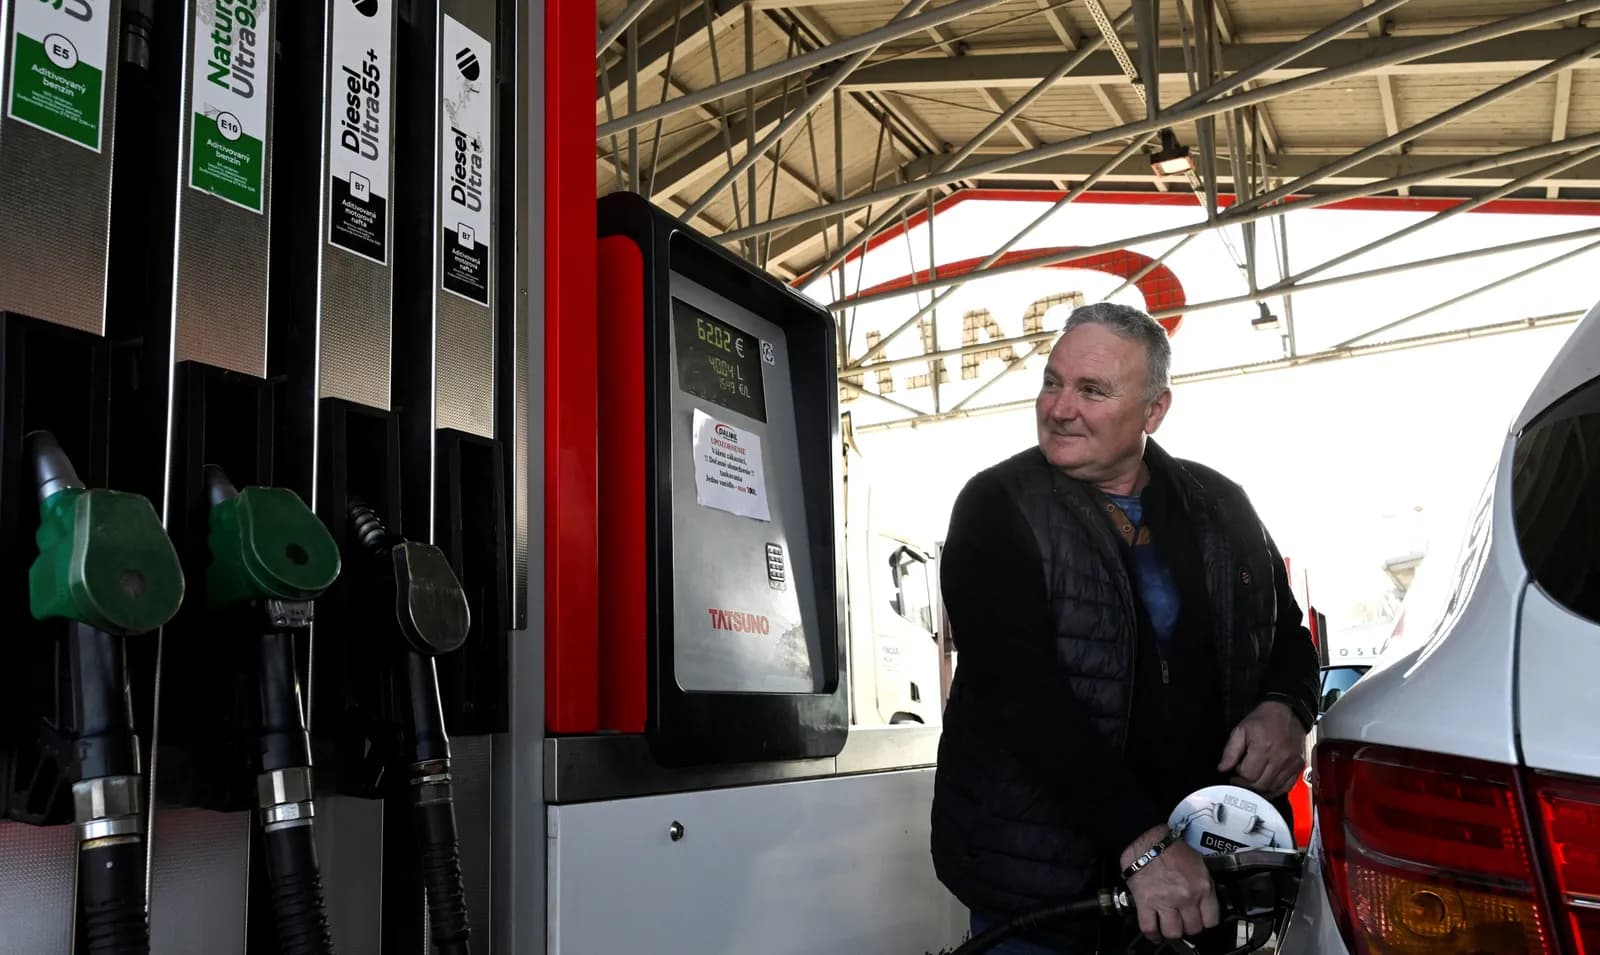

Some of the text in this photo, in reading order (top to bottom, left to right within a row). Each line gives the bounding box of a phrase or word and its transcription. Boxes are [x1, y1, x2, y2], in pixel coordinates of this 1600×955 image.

[53, 43, 70, 60] E5
[207, 0, 233, 90] Natur
[31, 64, 87, 95] Aditivovaný
[341, 65, 361, 154] Diesel
[360, 48, 381, 161] Ultra55+
[221, 119, 238, 133] E10
[451, 126, 467, 207] Diesel
[467, 139, 482, 212] Ultra+
[354, 181, 365, 192] B7
[351, 217, 368, 228] nafta
[462, 231, 471, 241] B7
[735, 337, 745, 358] €
[736, 364, 744, 381] L
[708, 608, 770, 636] TATSUNO
